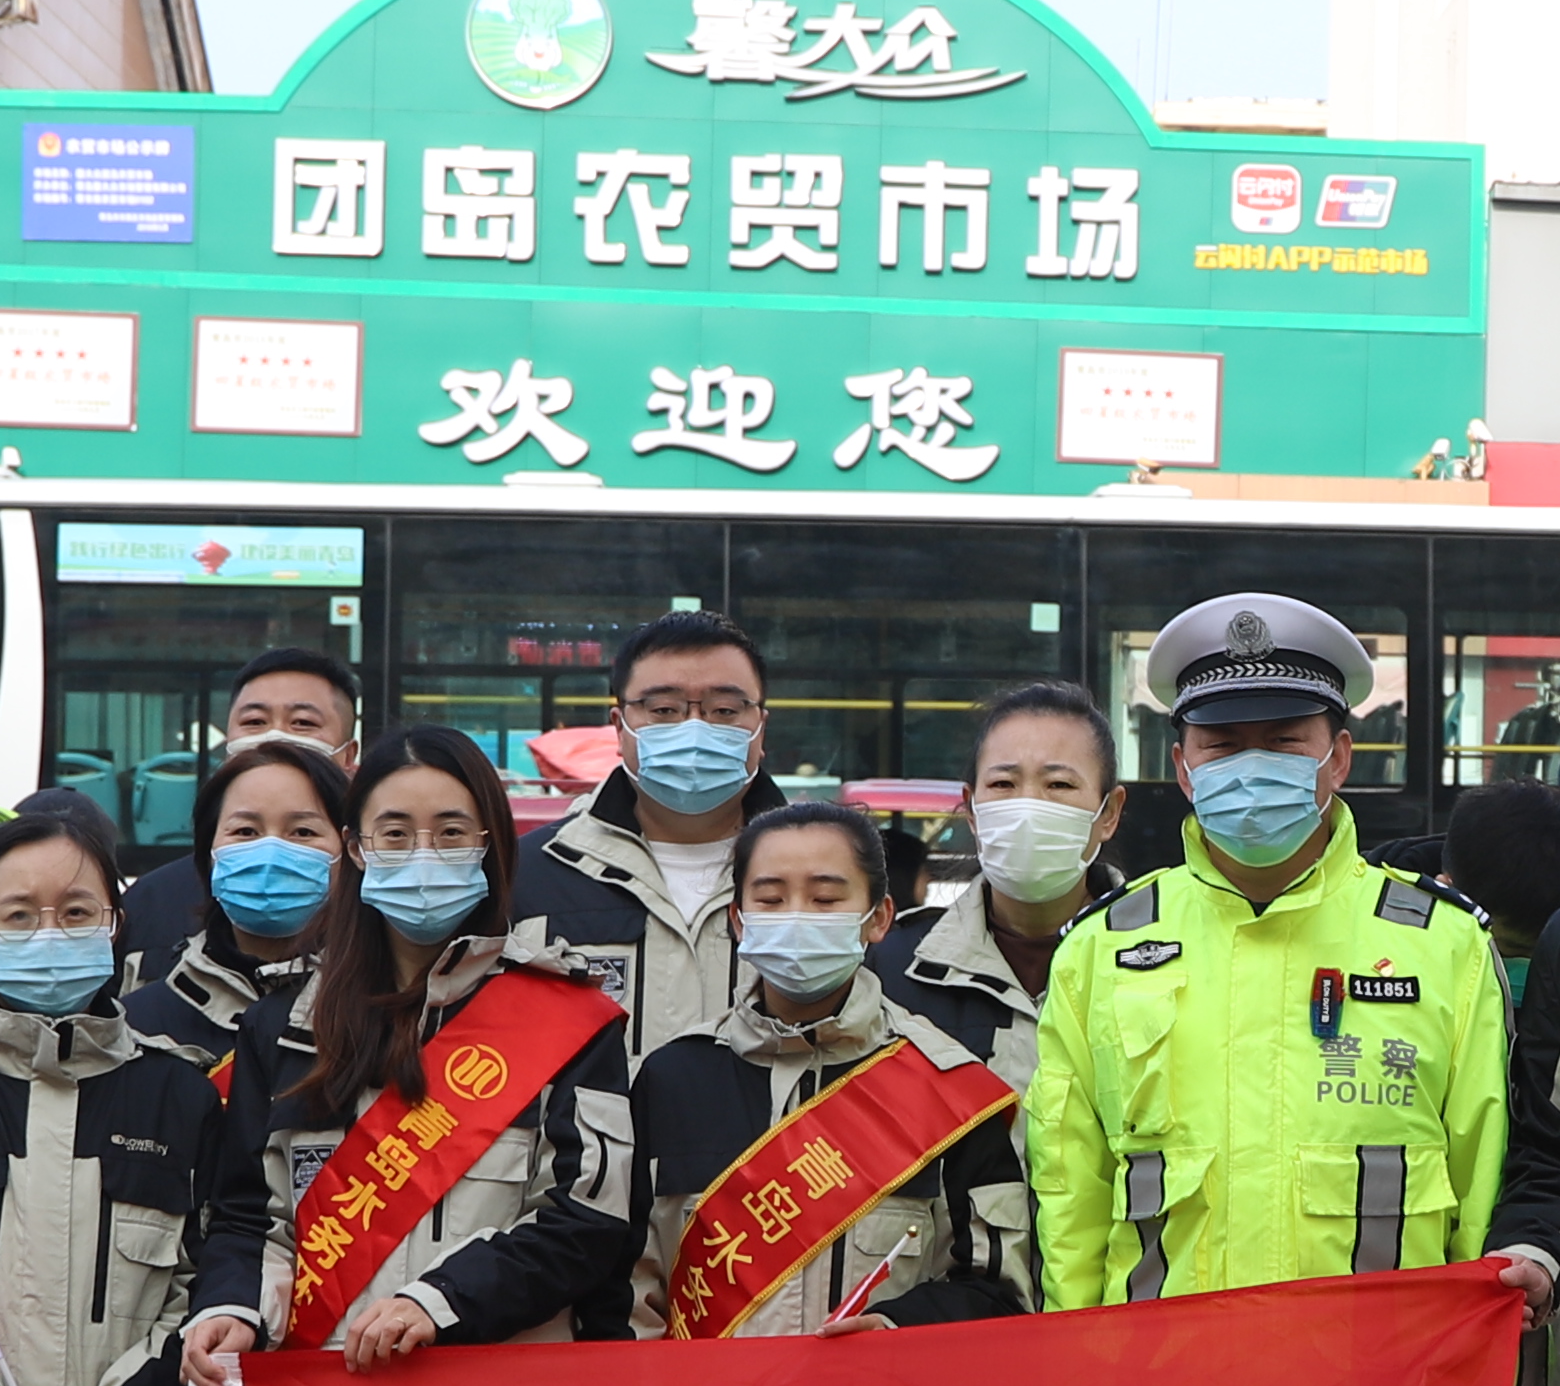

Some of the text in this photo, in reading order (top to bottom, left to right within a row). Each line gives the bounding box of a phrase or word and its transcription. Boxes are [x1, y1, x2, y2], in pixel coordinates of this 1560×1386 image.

[271, 136, 1143, 281] 团岛农贸市场
[419, 358, 999, 480] 欢迎您
[1354, 979, 1415, 998] 111851
[1318, 1035, 1420, 1081] 警察
[1316, 1082, 1417, 1108] POLICE
